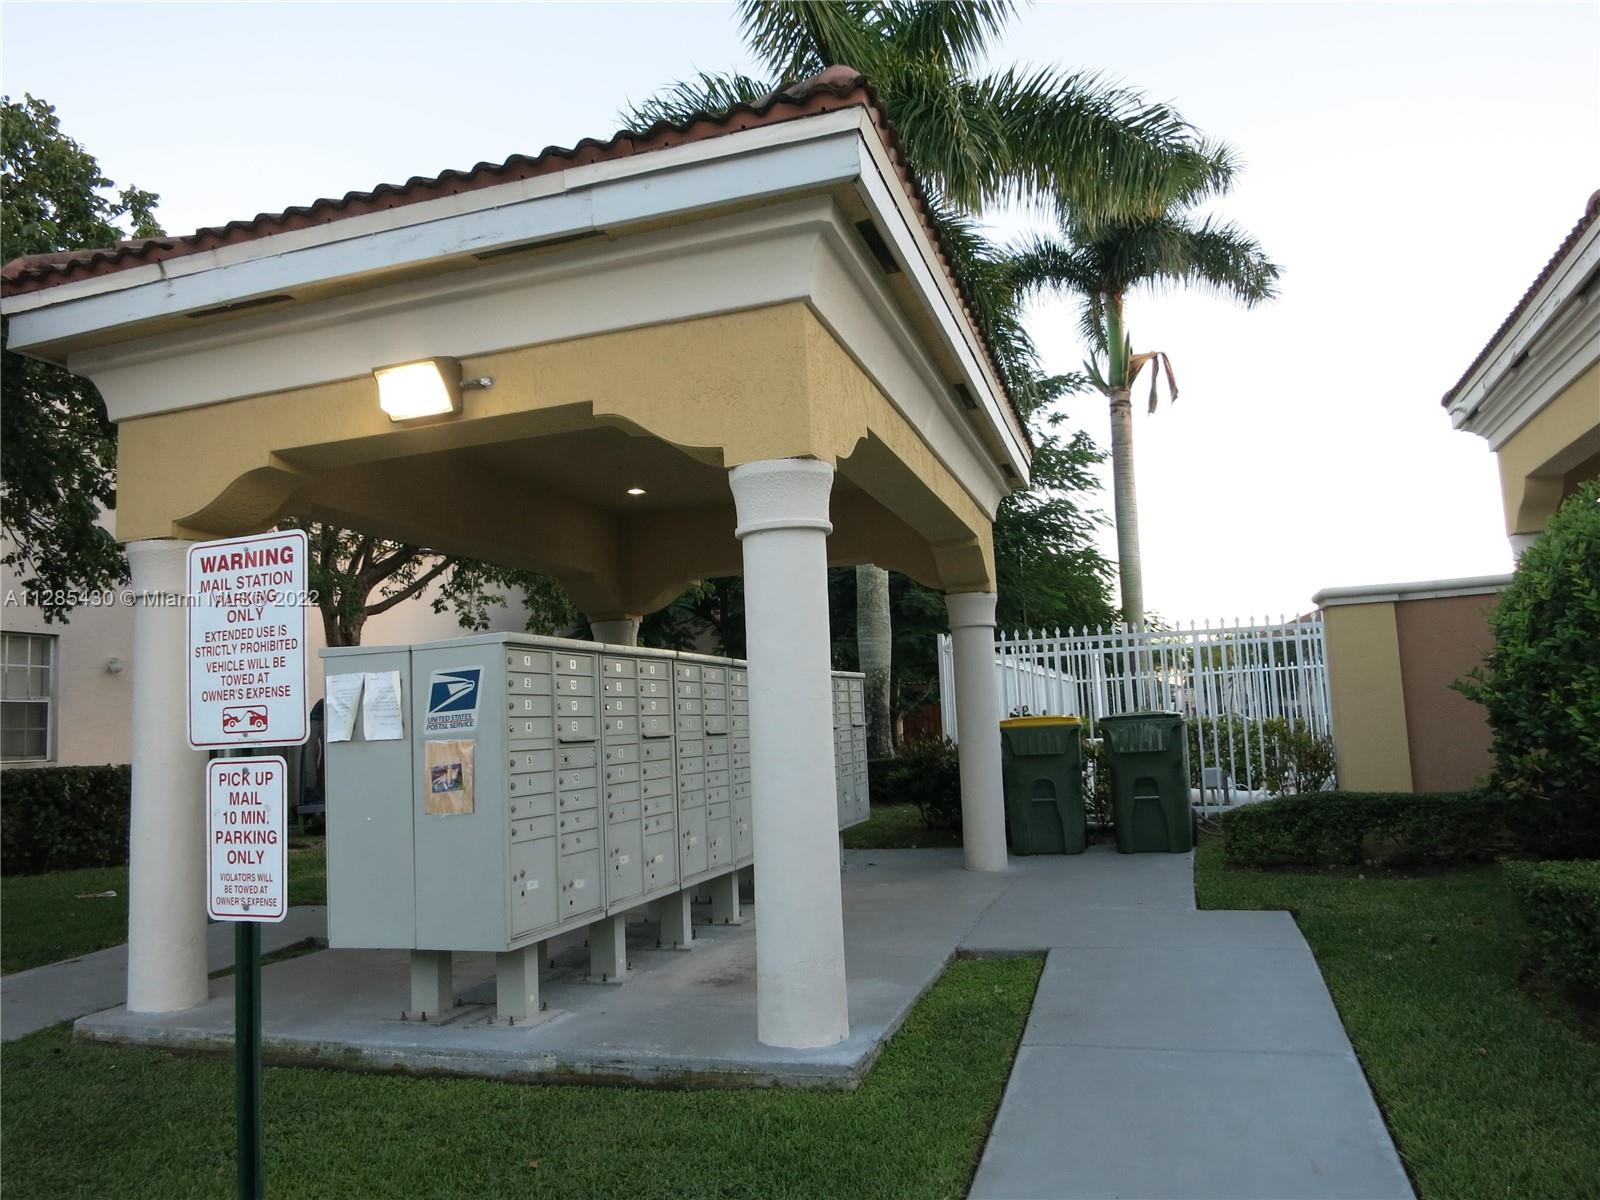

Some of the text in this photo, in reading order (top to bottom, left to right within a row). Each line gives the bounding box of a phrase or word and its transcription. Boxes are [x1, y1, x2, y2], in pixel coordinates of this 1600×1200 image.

[200, 546, 294, 573] WARNING
[200, 570, 293, 593] MAIL STATION
[215, 589, 277, 608] PARKING
[227, 607, 264, 624] ONLY
[205, 624, 287, 643] EXTENDED USE IS
[195, 638, 298, 658] STRICTLY PROHIBITED
[206, 656, 286, 673] VEHICLE WILL BE
[220, 672, 270, 687] TOWED AT
[201, 685, 291, 703] OWNER'S EXPENSE
[426, 718, 475, 731] POSTAL SERVICE
[427, 712, 473, 724] UNITED STATES
[218, 771, 274, 787] PICK UP
[229, 791, 262, 806] MAIL
[223, 810, 270, 825] 10 MIN.
[215, 830, 278, 845] PARKING
[227, 850, 265, 865] ONLY
[219, 872, 273, 883] VIOLATORS WILL
[224, 884, 268, 894] BE TOWED AT
[216, 896, 278, 907] OWNER'S EXPENSE
